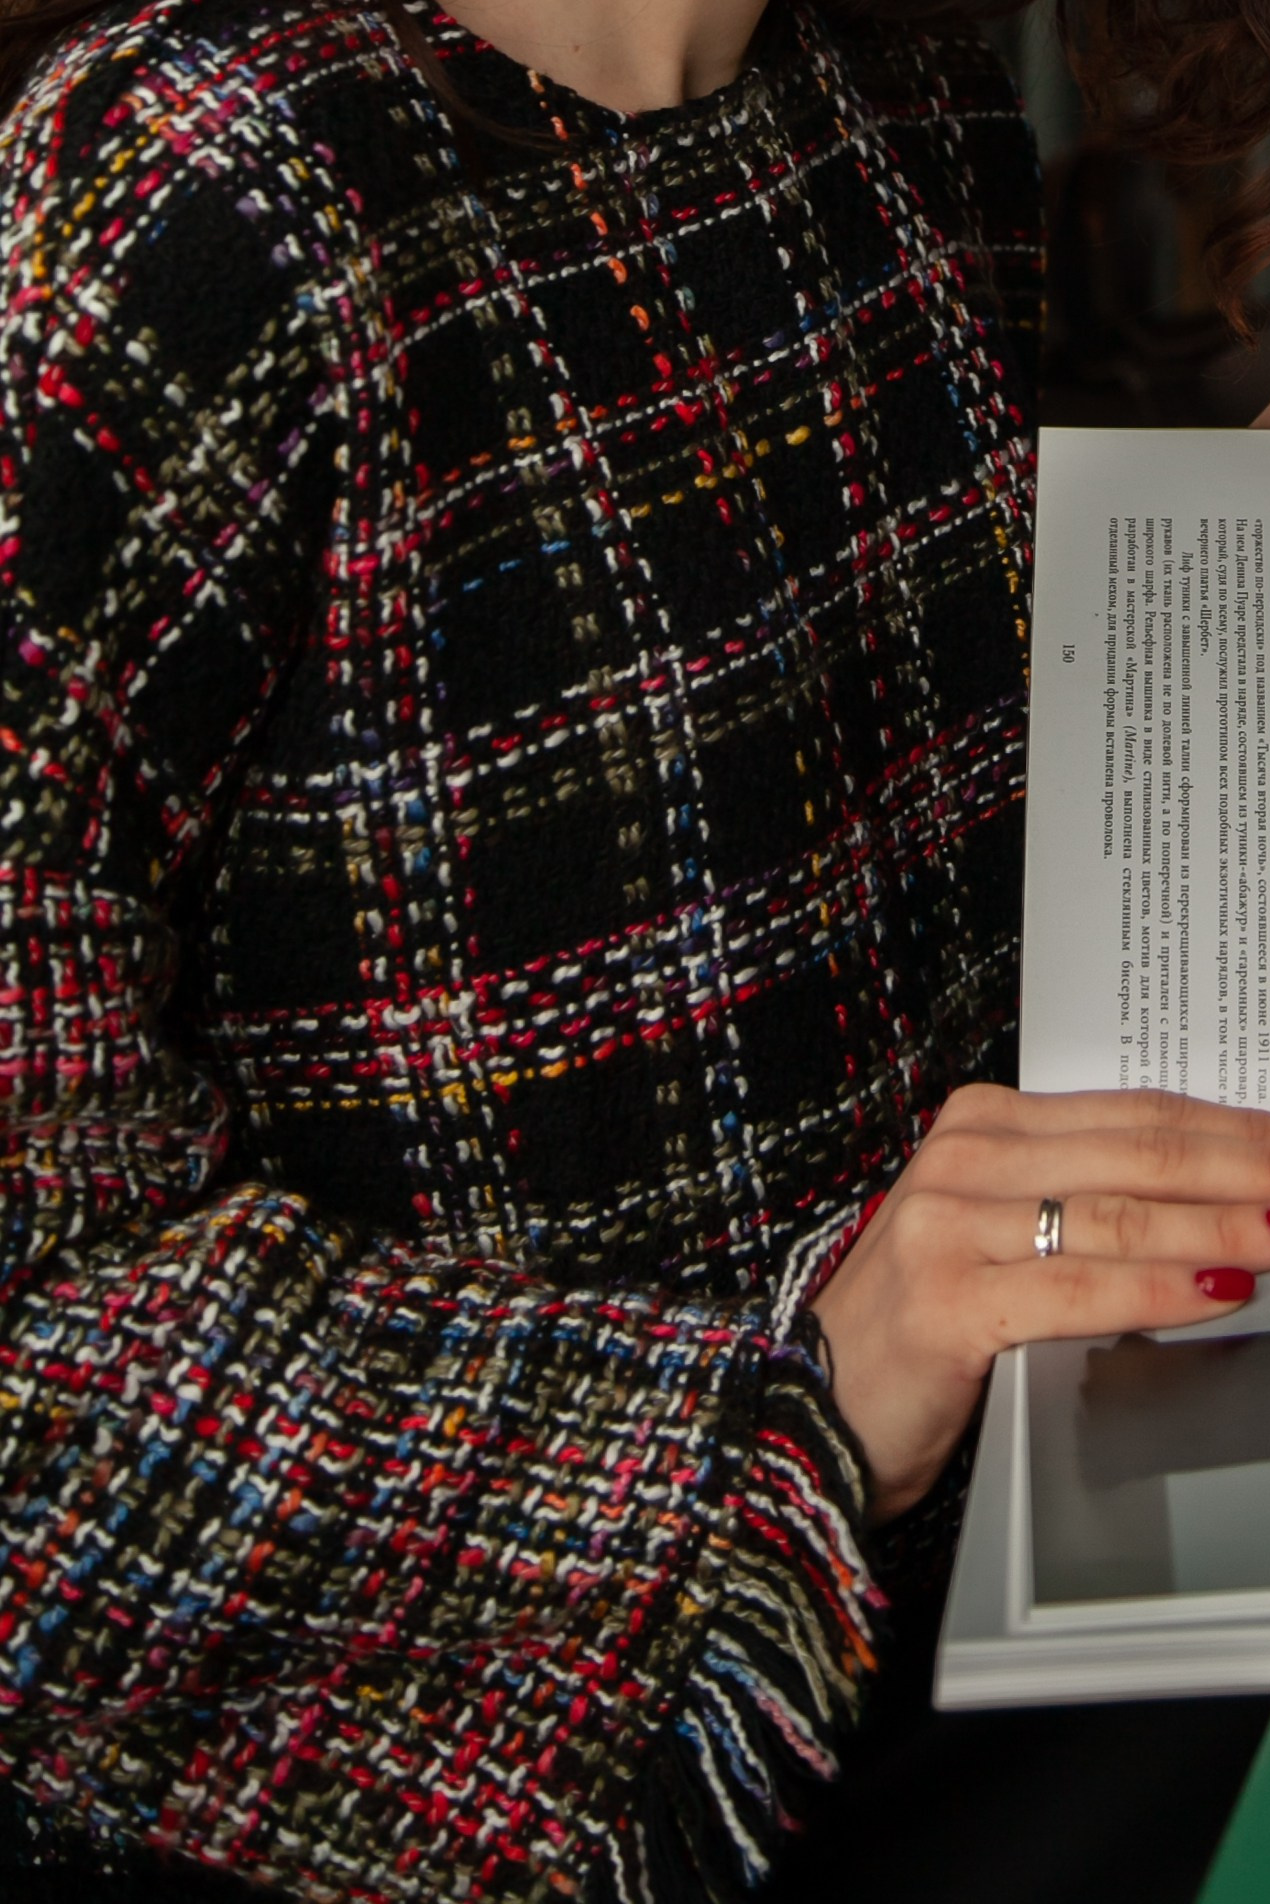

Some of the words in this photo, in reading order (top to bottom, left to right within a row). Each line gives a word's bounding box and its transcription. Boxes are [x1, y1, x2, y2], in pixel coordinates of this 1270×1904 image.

[1109, 517, 1119, 574] отделанный
[1125, 518, 1139, 572] разработан
[1143, 518, 1154, 566] широкого
[1161, 518, 1173, 555] рукавов
[1197, 518, 1209, 565] вечернего
[1215, 518, 1229, 562] который,
[1108, 577, 1117, 611] мехом,
[1142, 570, 1157, 606] шарфа.
[1164, 579, 1172, 608] ткань
[1180, 576, 1191, 612] туники
[1201, 568, 1209, 601] платья
[1236, 554, 1248, 589] Дениза
[1124, 590, 1137, 649] мастерской
[1216, 604, 1227, 636] всему,
[1235, 592, 1249, 622] Пуаре
[1063, 644, 1075, 663] 150
[1105, 634, 1116, 685] придания
[1142, 611, 1157, 665] Рельефная
[1161, 612, 1172, 679] расположена
[1182, 624, 1192, 690] завышенной
[1216, 638, 1228, 690] послужил
[1235, 624, 1246, 676] предстала
[1104, 688, 1119, 728] формы
[1145, 671, 1153, 721] вышивка
[1182, 694, 1192, 735] линией
[1235, 688, 1247, 729] наряде,
[1257, 677, 1265, 734] названием
[1163, 720, 1173, 766] долевой
[1217, 693, 1228, 761] прототипом
[1106, 731, 1115, 787] вставлена
[1123, 725, 1137, 783] (Martine),
[1182, 739, 1190, 772] талии
[1239, 731, 1247, 801] состоявшем
[1102, 791, 1114, 859] проволока.
[1124, 790, 1133, 859] выполнена
[1143, 770, 1152, 864] стилизованных
[1178, 776, 1194, 860] сформирован
[1219, 793, 1232, 854] подобных
[1255, 790, 1266, 831] вторая
[1122, 867, 1132, 951] стеклянным
[1141, 871, 1151, 919] цветов,
[1159, 842, 1173, 924] поперечной)
[1220, 858, 1228, 936] экзотичных
[1142, 926, 1150, 968] мотив
[1259, 879, 1267, 971] состоявшееся
[1158, 946, 1170, 1010] притален
[1178, 884, 1190, 1031] перекрещивающихся
[1216, 941, 1228, 1002] нарядов,
[1118, 960, 1134, 1026] бисером.
[1259, 989, 1267, 1026] июне
[1137, 1007, 1151, 1067] которой
[1259, 1033, 1270, 1061] 1911
[1219, 1049, 1228, 1090] числе
